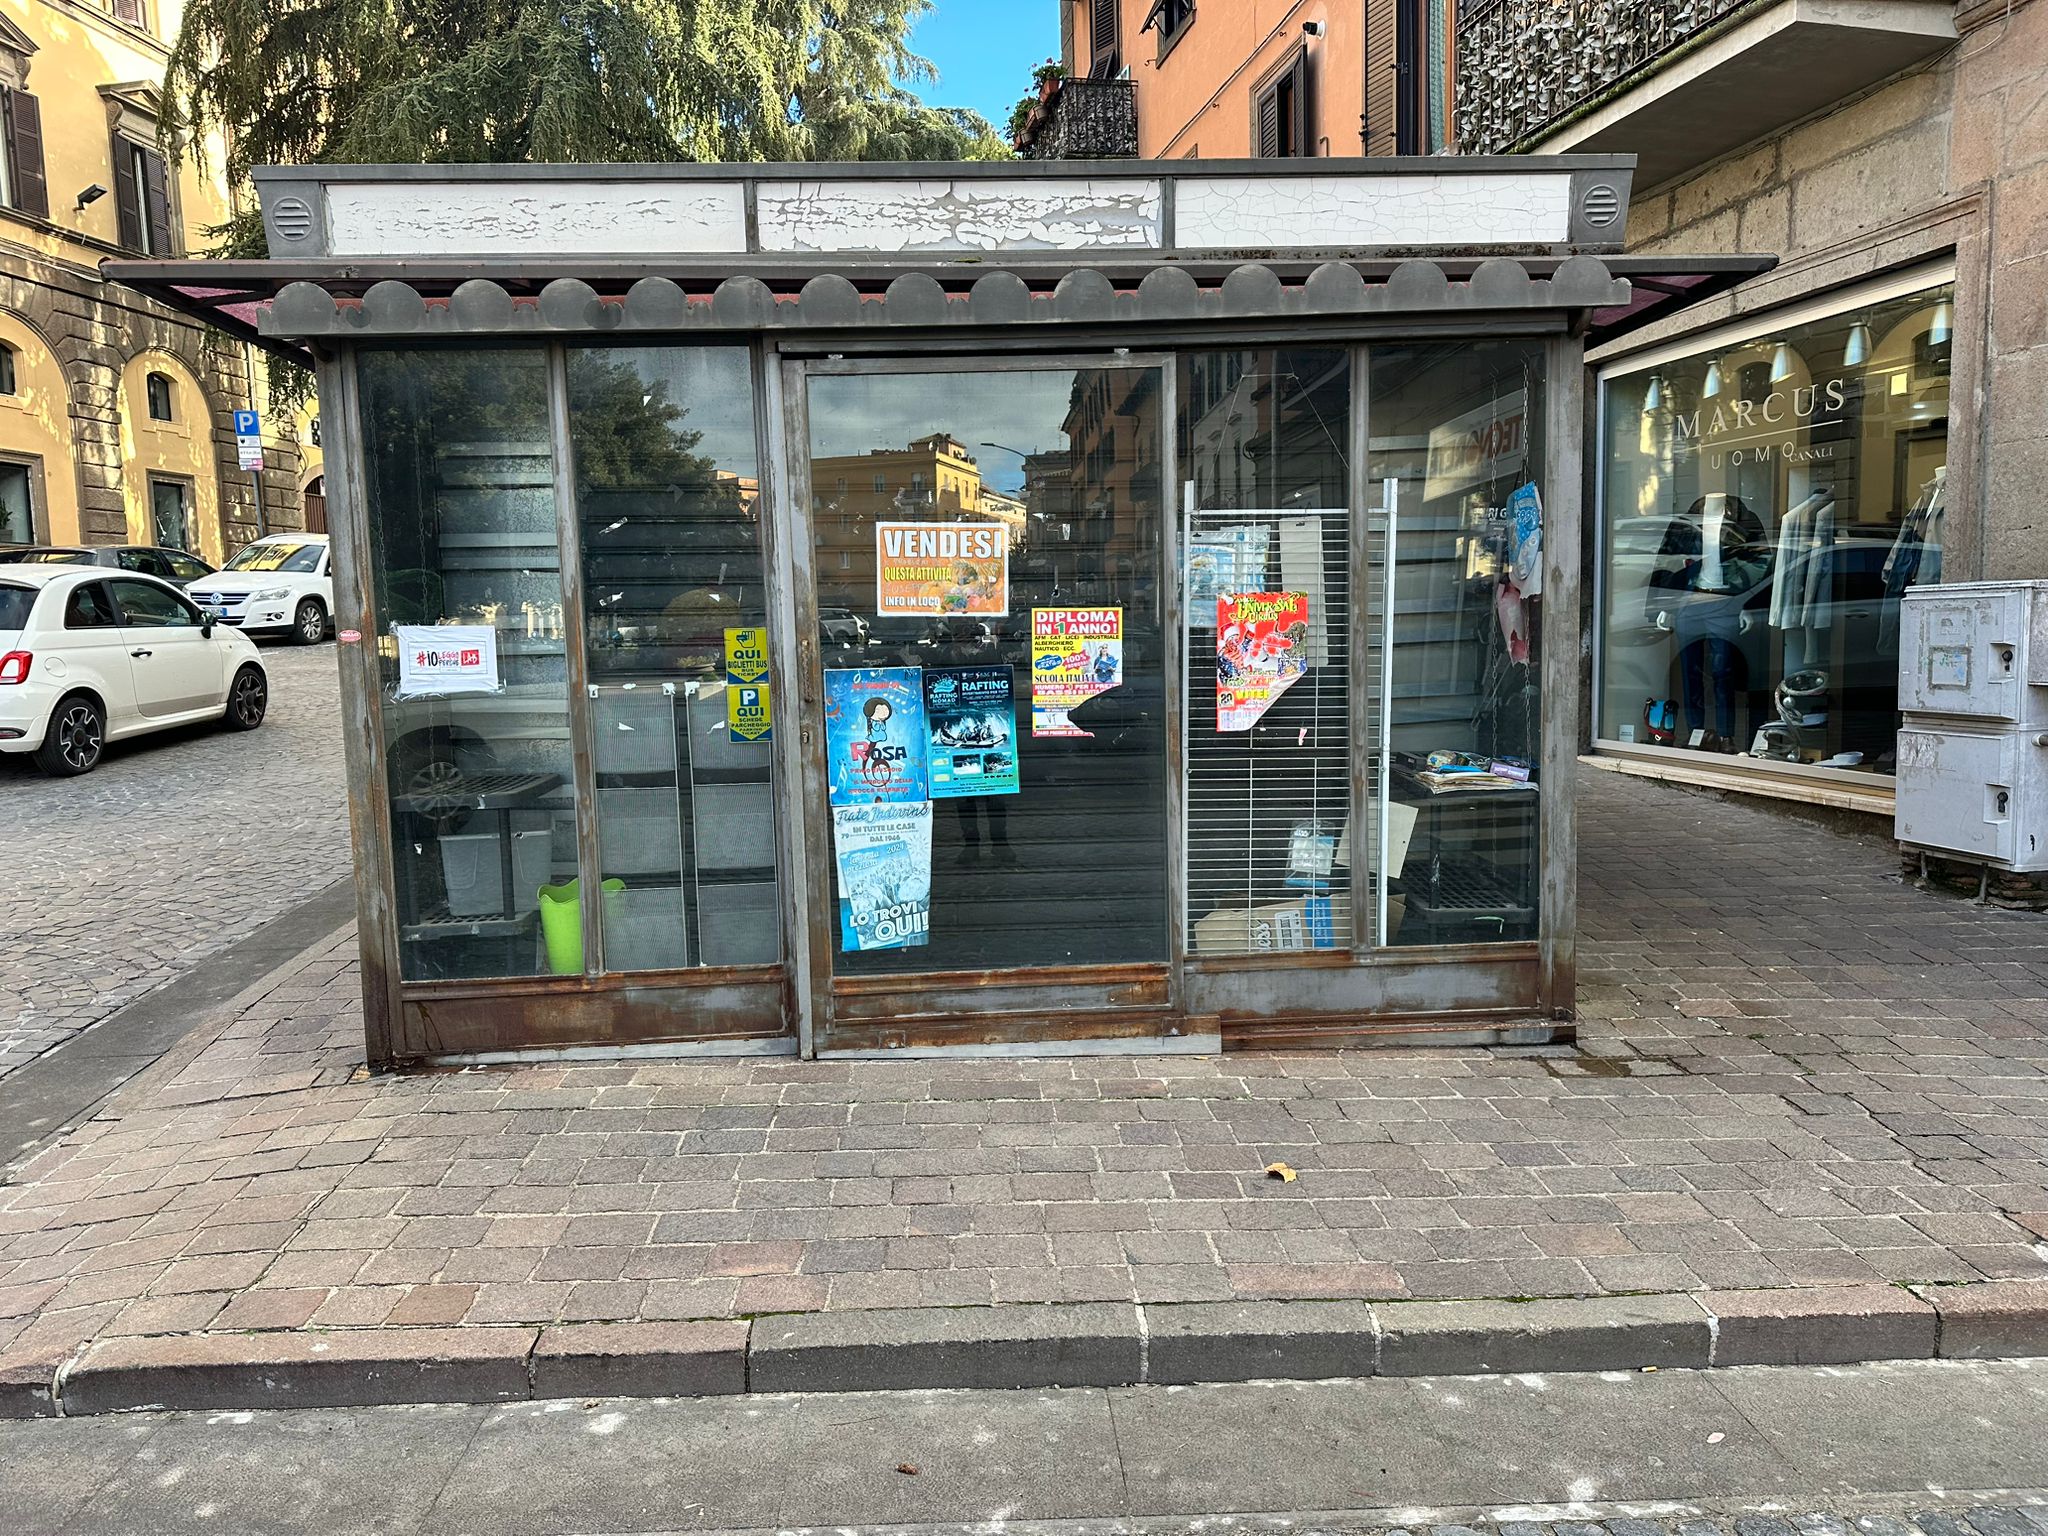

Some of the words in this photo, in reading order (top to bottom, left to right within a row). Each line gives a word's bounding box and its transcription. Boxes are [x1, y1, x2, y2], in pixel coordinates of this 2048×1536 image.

[1675, 378, 1845, 439] MARCUS
[239, 413, 253, 432] P
[1711, 441, 1795, 470] UOMO
[1789, 447, 1833, 463] CANALI
[882, 530, 1002, 558] VENDESI
[884, 567, 915, 582] QUESTA
[885, 597, 905, 607] INFO
[907, 597, 917, 607] IN
[918, 597, 940, 607] LOCO
[1036, 611, 1117, 622] DIPLOMA
[1037, 623, 1052, 634] IN
[1054, 622, 1066, 634] 1
[733, 649, 760, 659] QUI
[728, 660, 755, 669] BIGLIETTI
[756, 660, 768, 669] BUS
[961, 680, 1009, 691] RAFTING
[1035, 674, 1064, 682] SCUOLA
[742, 690, 756, 705] P
[736, 707, 764, 717] QUI
[850, 742, 907, 761] ROSA
[836, 808, 868, 825] Frate
[850, 912, 869, 927] LO
[872, 901, 918, 922] TROVI
[875, 911, 929, 941] QUI!
